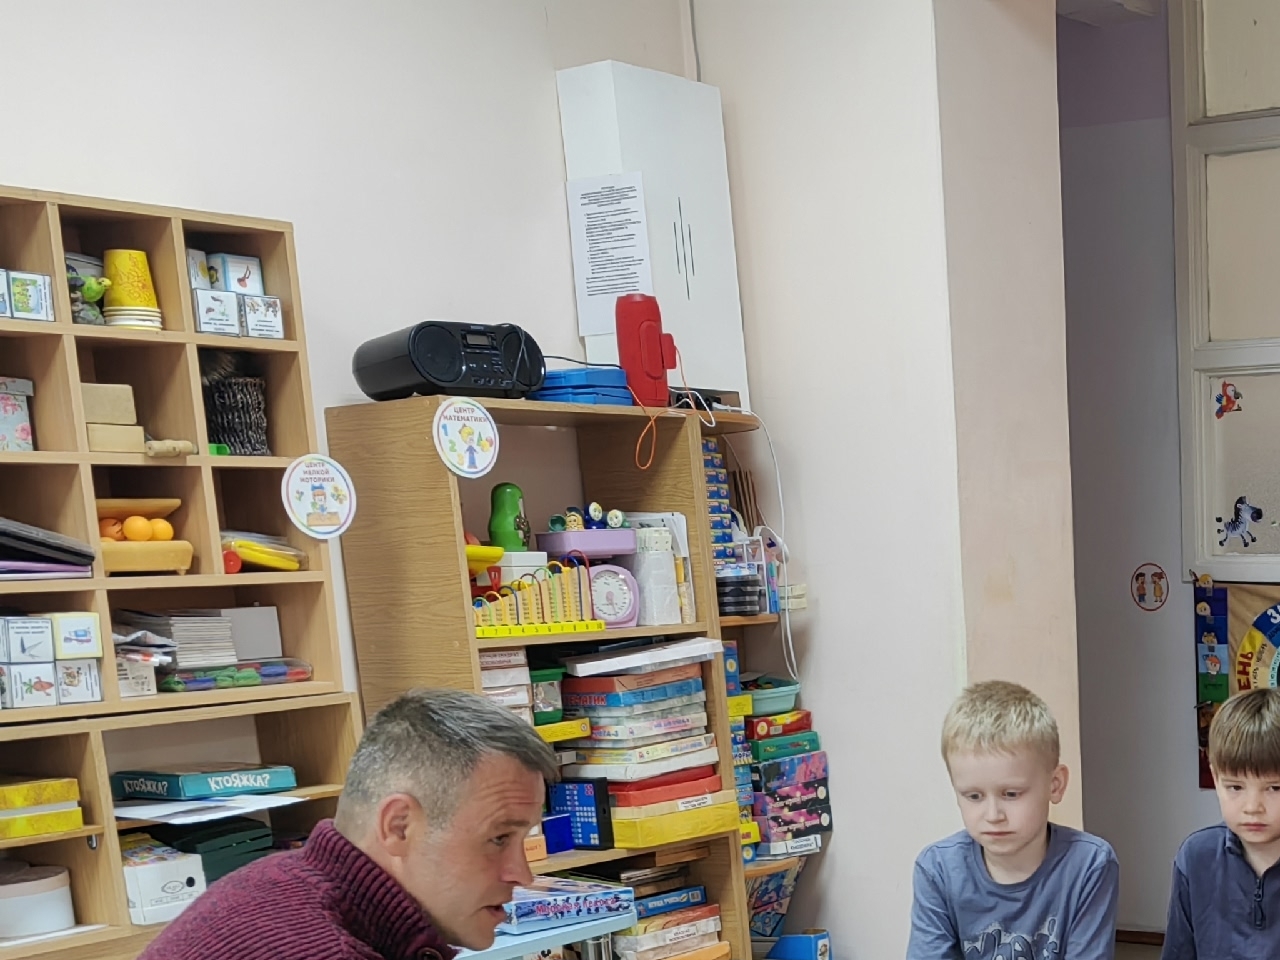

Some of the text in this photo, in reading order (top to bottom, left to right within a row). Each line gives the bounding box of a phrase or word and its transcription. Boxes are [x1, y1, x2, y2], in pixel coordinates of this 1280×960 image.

[442, 414, 488, 423] МАТЕМАТИКИ
[1237, 651, 1254, 691] ЕНЬ
[123, 778, 168, 795] КТОЯЖКА?
[207, 773, 270, 791] КТОЯЖКА?
